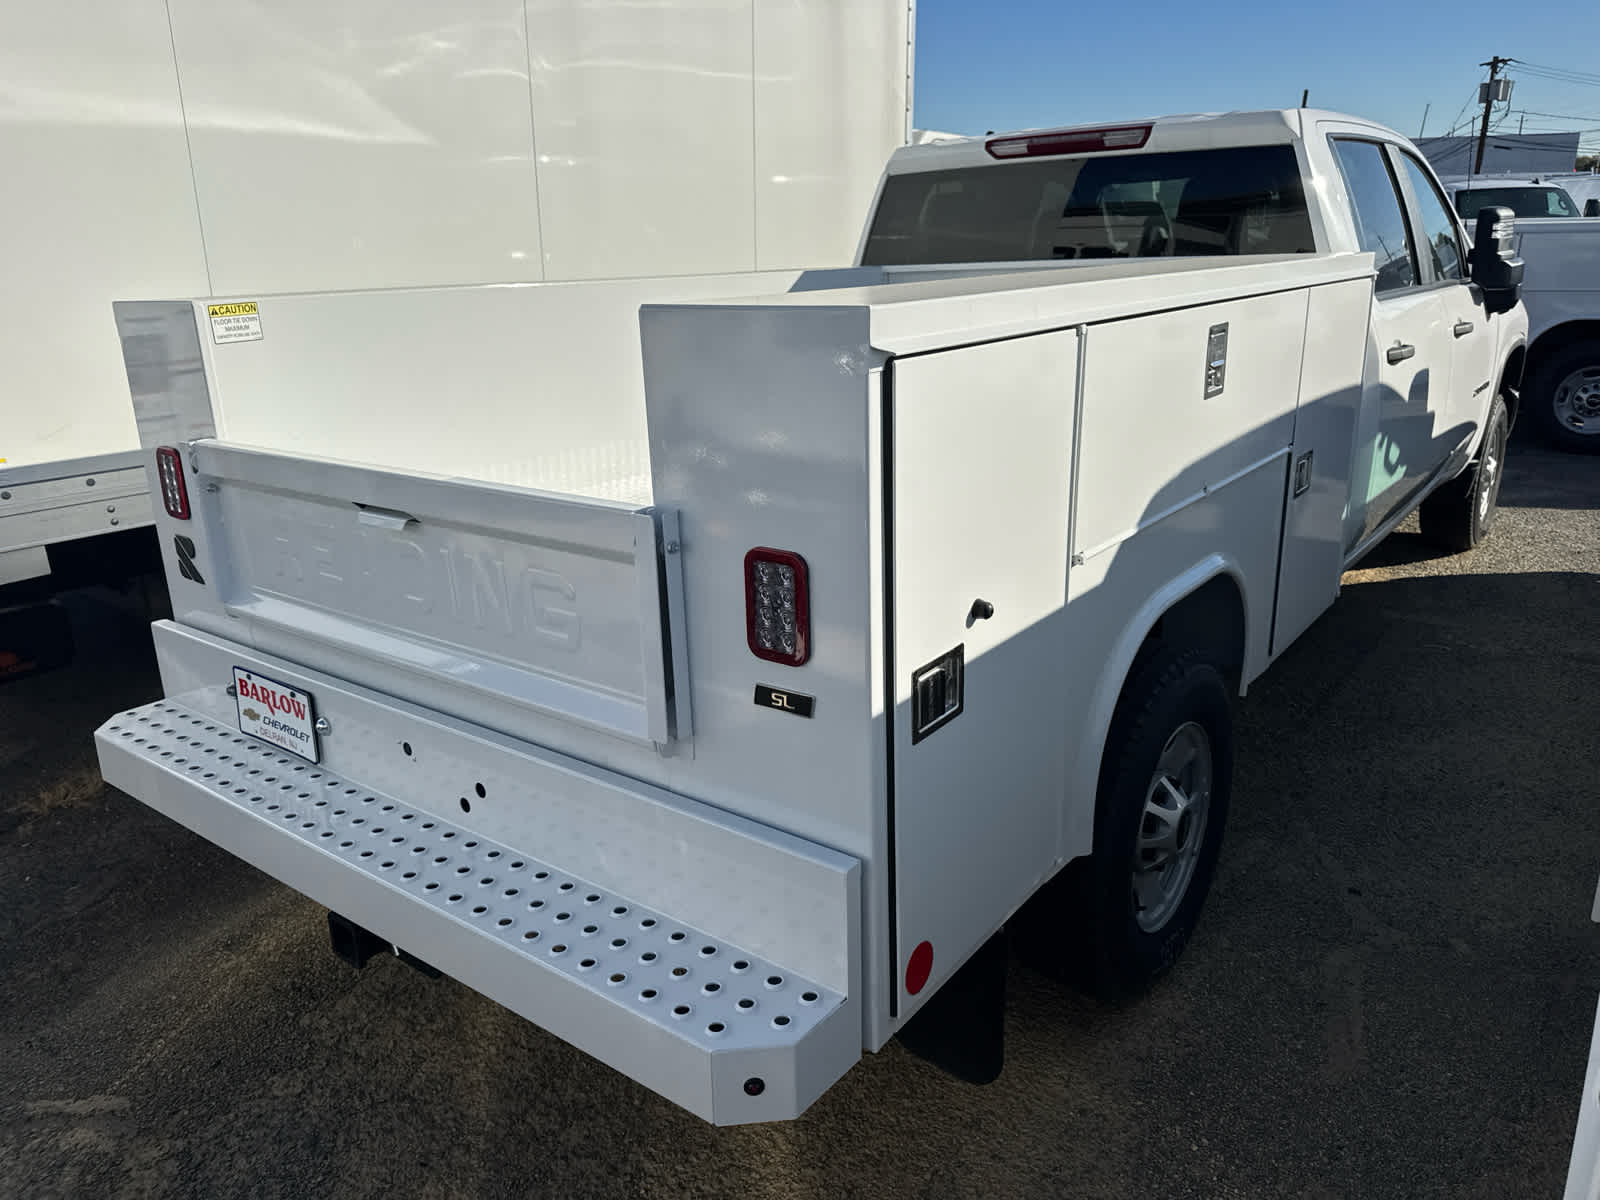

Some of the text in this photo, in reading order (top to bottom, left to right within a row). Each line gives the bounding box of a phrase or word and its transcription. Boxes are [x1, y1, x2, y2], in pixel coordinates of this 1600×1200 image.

[218, 304, 257, 315] CAUTION
[238, 678, 306, 720] BARLOW
[771, 692, 795, 710] SL
[263, 716, 310, 743] CHEVROLET
